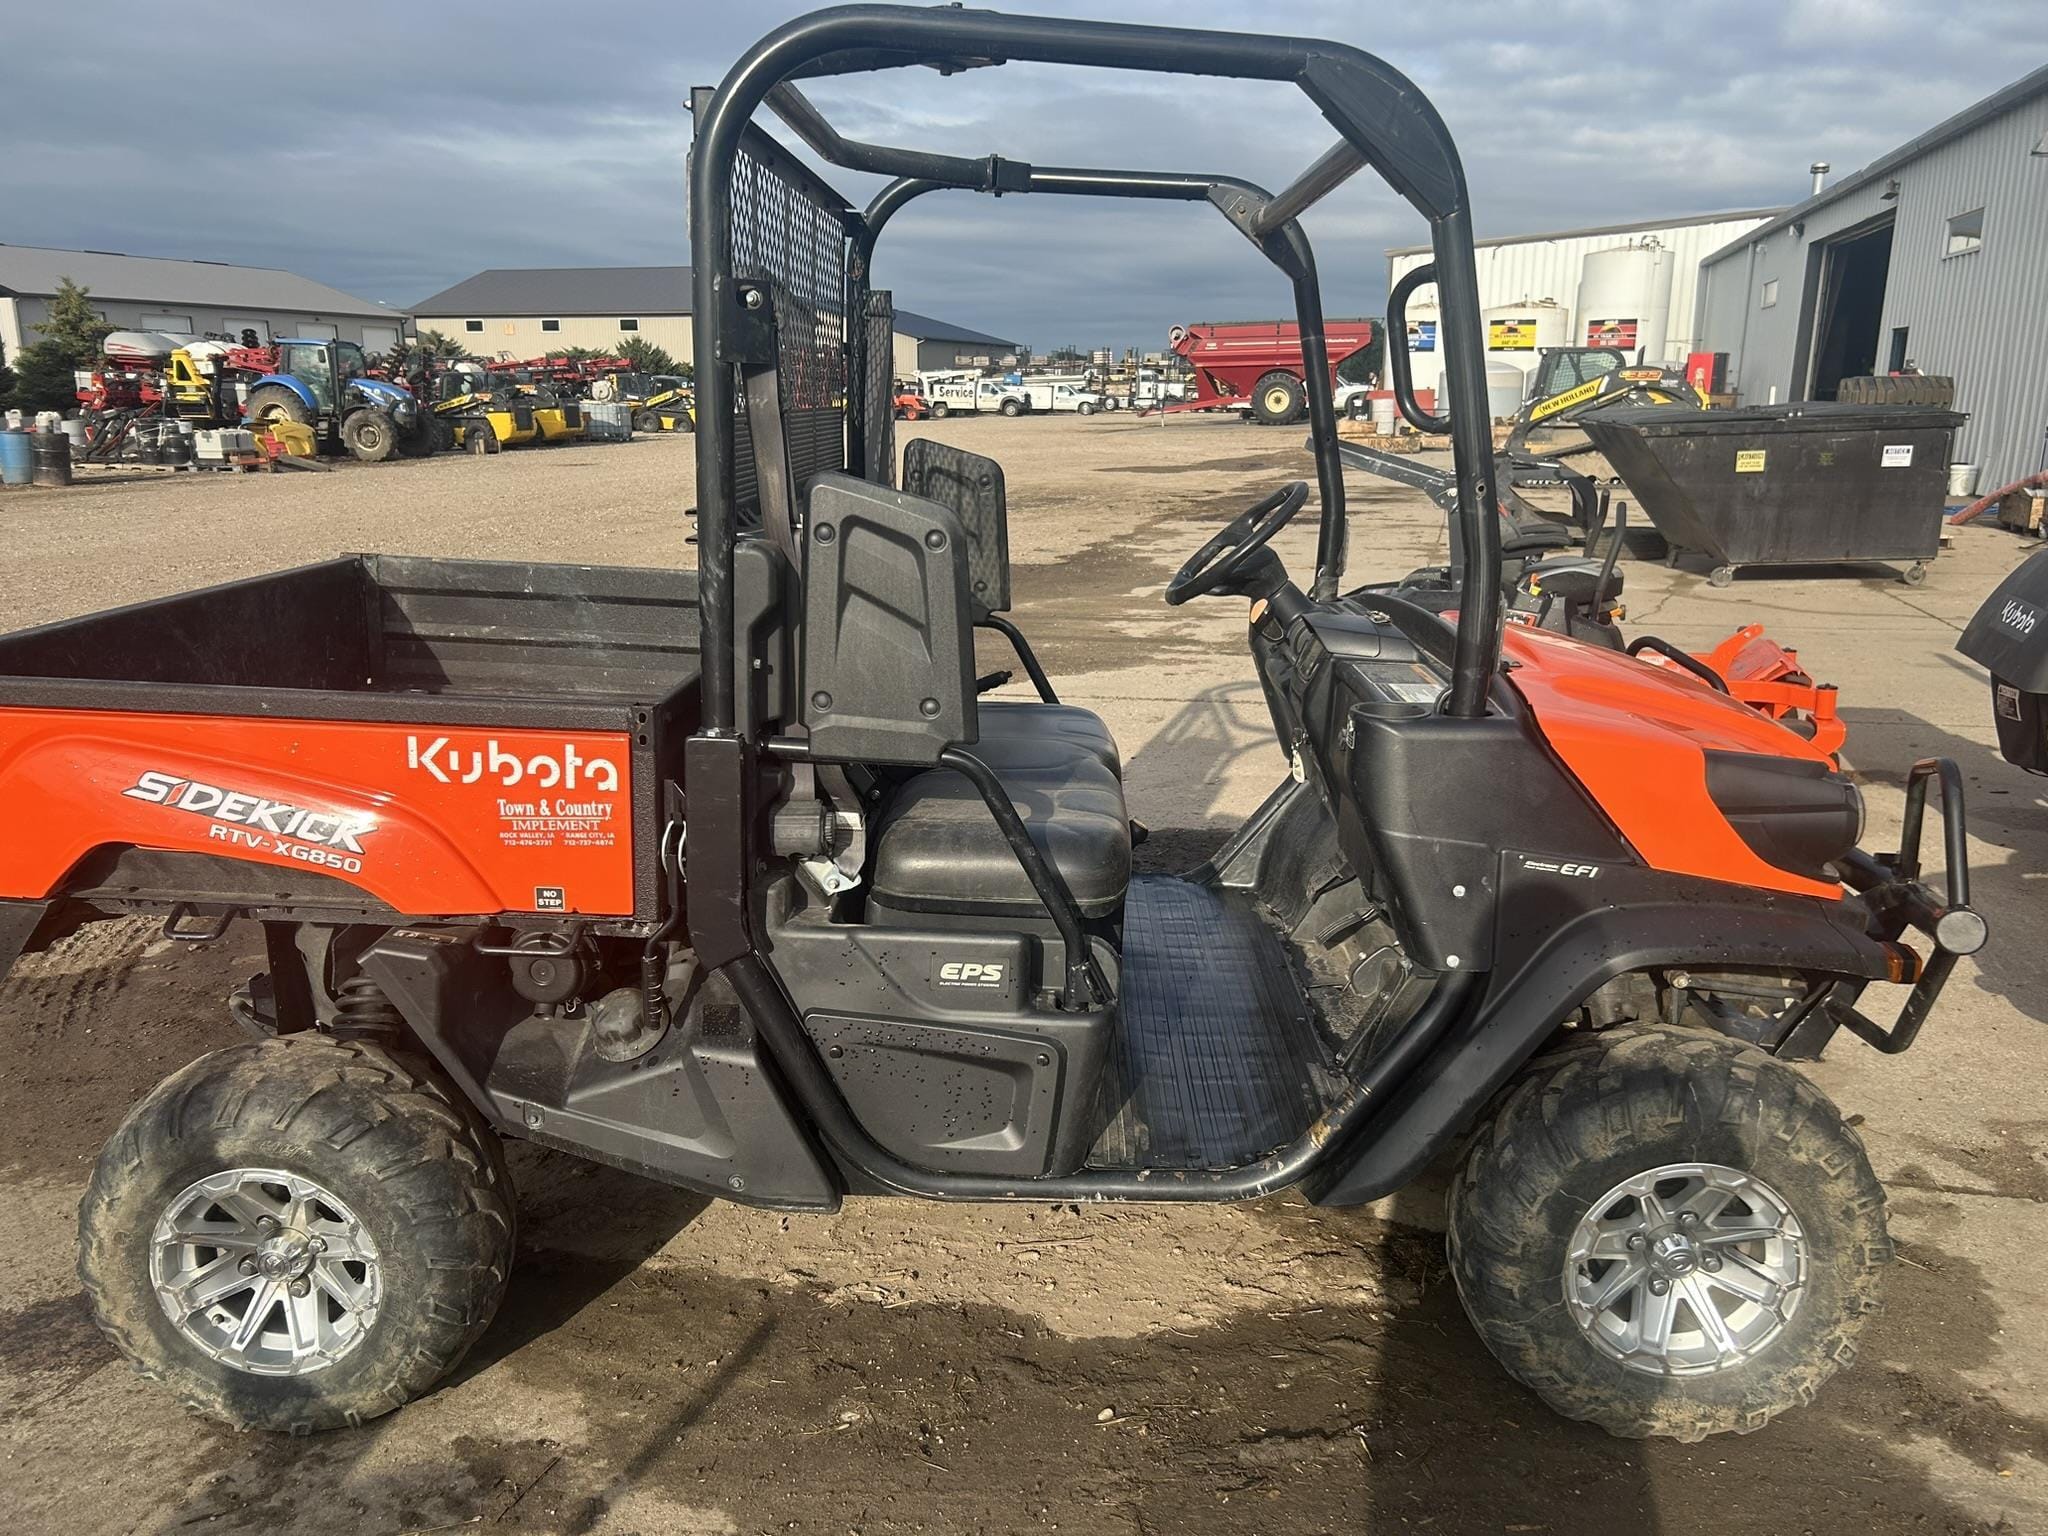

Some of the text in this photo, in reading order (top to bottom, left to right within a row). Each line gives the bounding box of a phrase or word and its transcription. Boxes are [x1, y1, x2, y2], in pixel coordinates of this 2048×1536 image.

[939, 386, 974, 398] Service
[1541, 384, 1595, 412] NEW HOLLAND
[2000, 599, 2036, 634] Kubota
[407, 735, 619, 792] Kubota
[121, 771, 378, 855] SIDEKICK
[497, 798, 613, 821] Town & Country
[512, 820, 601, 831] IMPLEMENT
[209, 823, 363, 874] RTV-XG850
[1560, 863, 1599, 878] EFI
[538, 898, 562, 906] STEP
[543, 890, 557, 898] NO
[940, 962, 1004, 982] EPS
